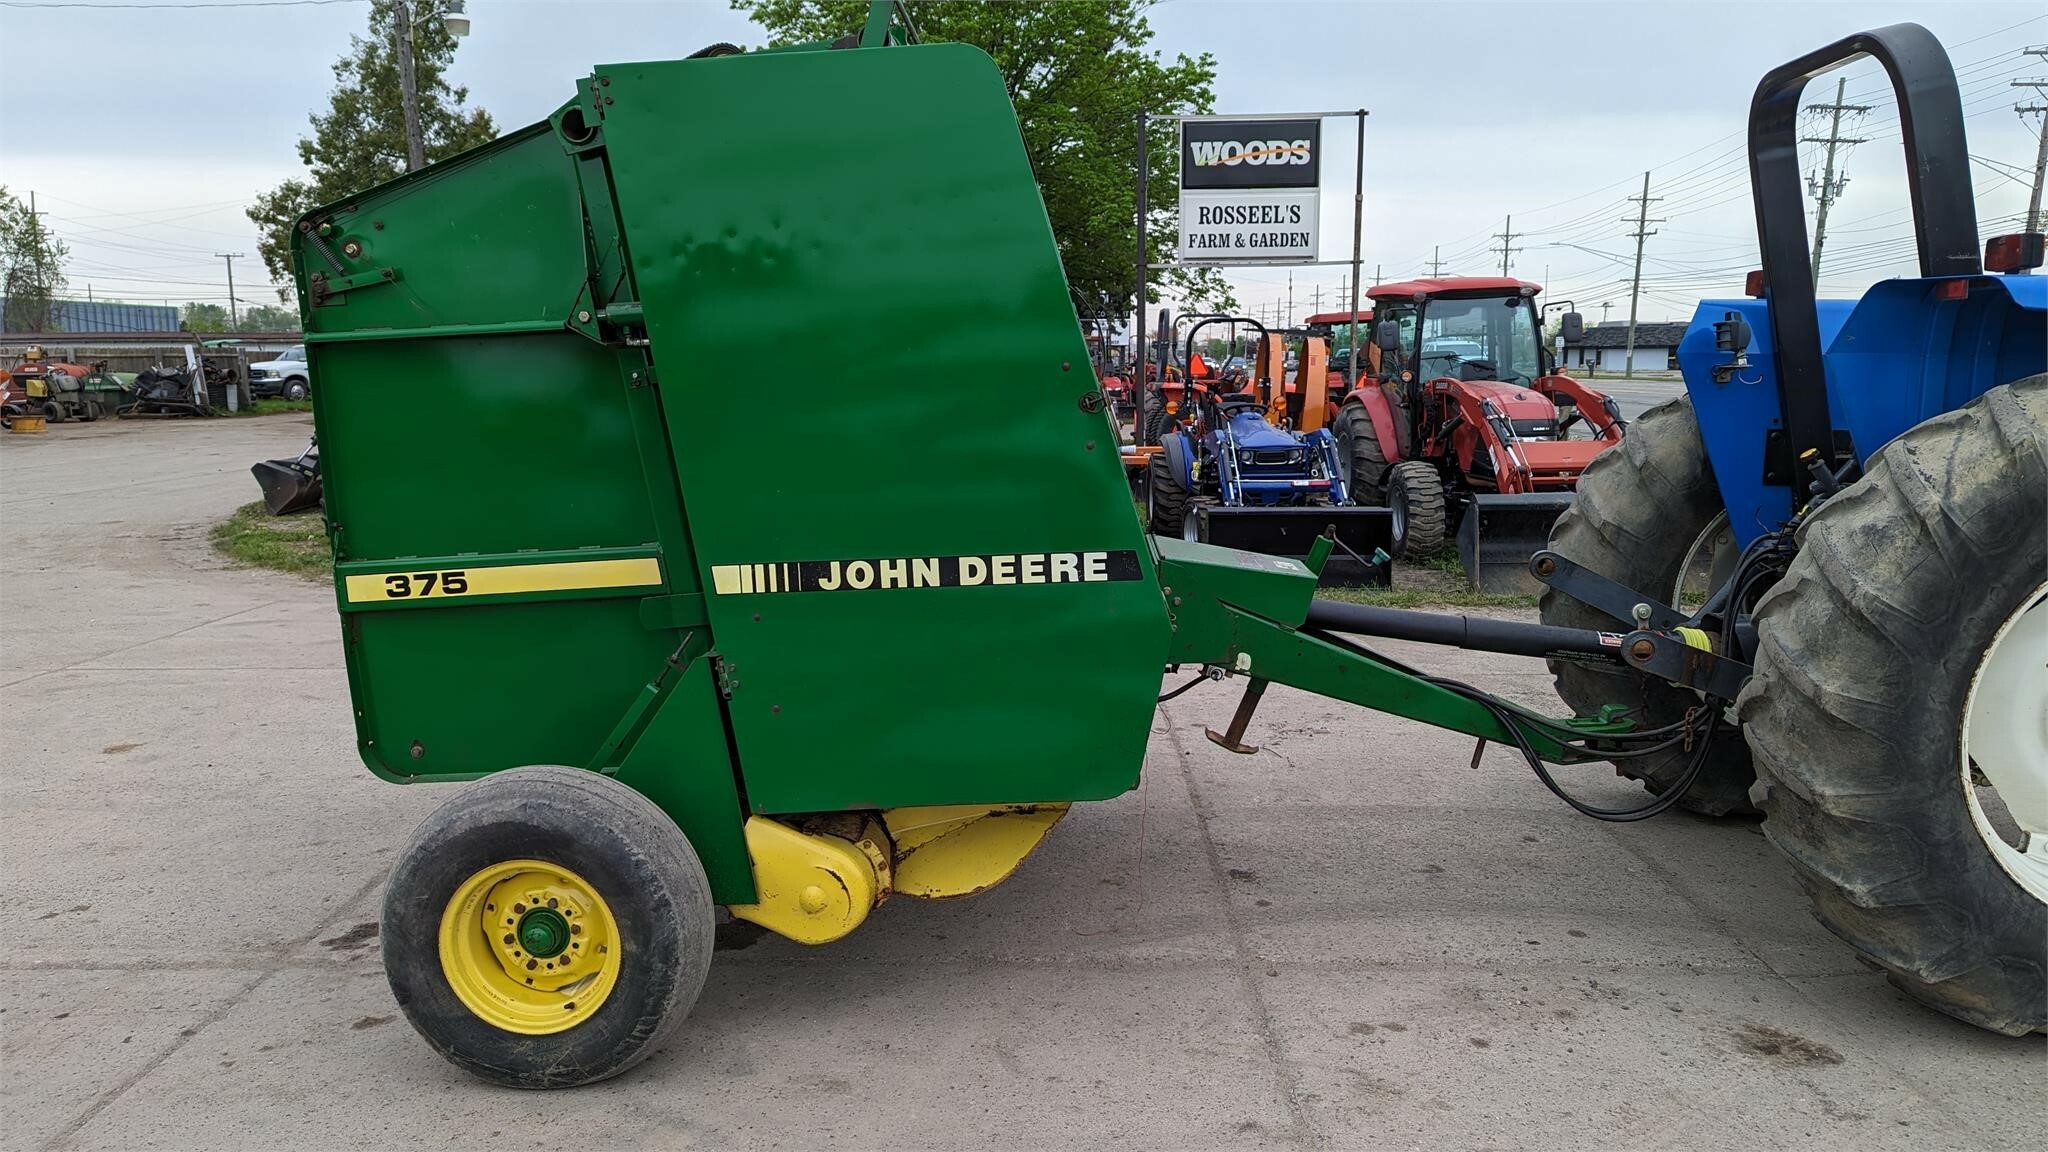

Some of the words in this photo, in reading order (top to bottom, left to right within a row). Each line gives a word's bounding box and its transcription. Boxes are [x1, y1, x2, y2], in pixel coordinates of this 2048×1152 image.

[1190, 139, 1311, 167] WOODS
[1198, 204, 1301, 225] ROSSEEL'S
[1188, 233, 1230, 249] FARM
[1234, 232, 1246, 248] &
[1249, 232, 1310, 248] GARDEN
[385, 571, 468, 598] 375
[818, 558, 940, 590] JOHN
[958, 552, 1108, 586] DEERE
